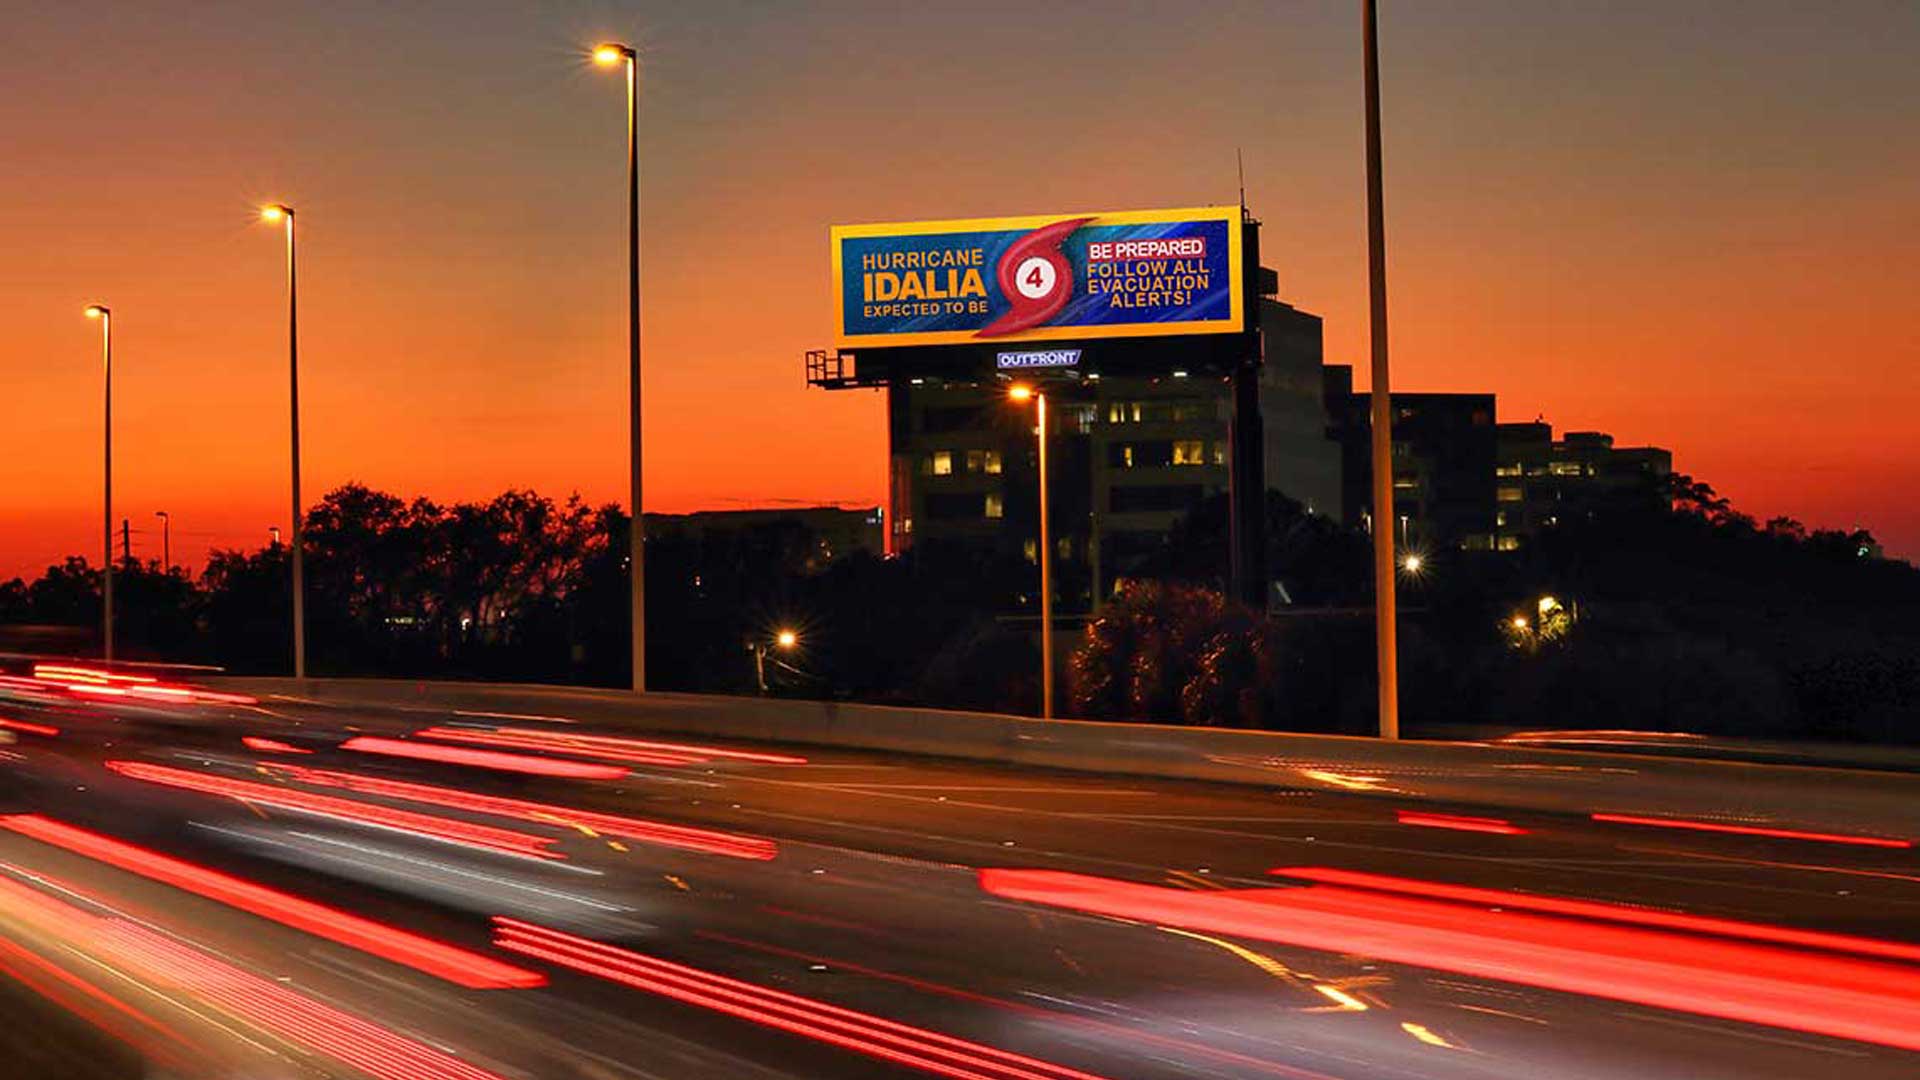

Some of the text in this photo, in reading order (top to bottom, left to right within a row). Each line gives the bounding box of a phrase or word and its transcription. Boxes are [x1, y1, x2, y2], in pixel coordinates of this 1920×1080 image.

[863, 248, 983, 270] HURRICANE
[1090, 240, 1203, 259] BE PREPARED
[1026, 266, 1044, 288] 4
[1087, 259, 1209, 278] FOLLOW ALL
[863, 268, 987, 302] IDALIA
[1088, 275, 1208, 294] EVACUATION
[863, 301, 988, 317] EXPECTED TO BE
[1110, 291, 1191, 308] ALERTS!
[1001, 351, 1076, 366] OUTFRONT
